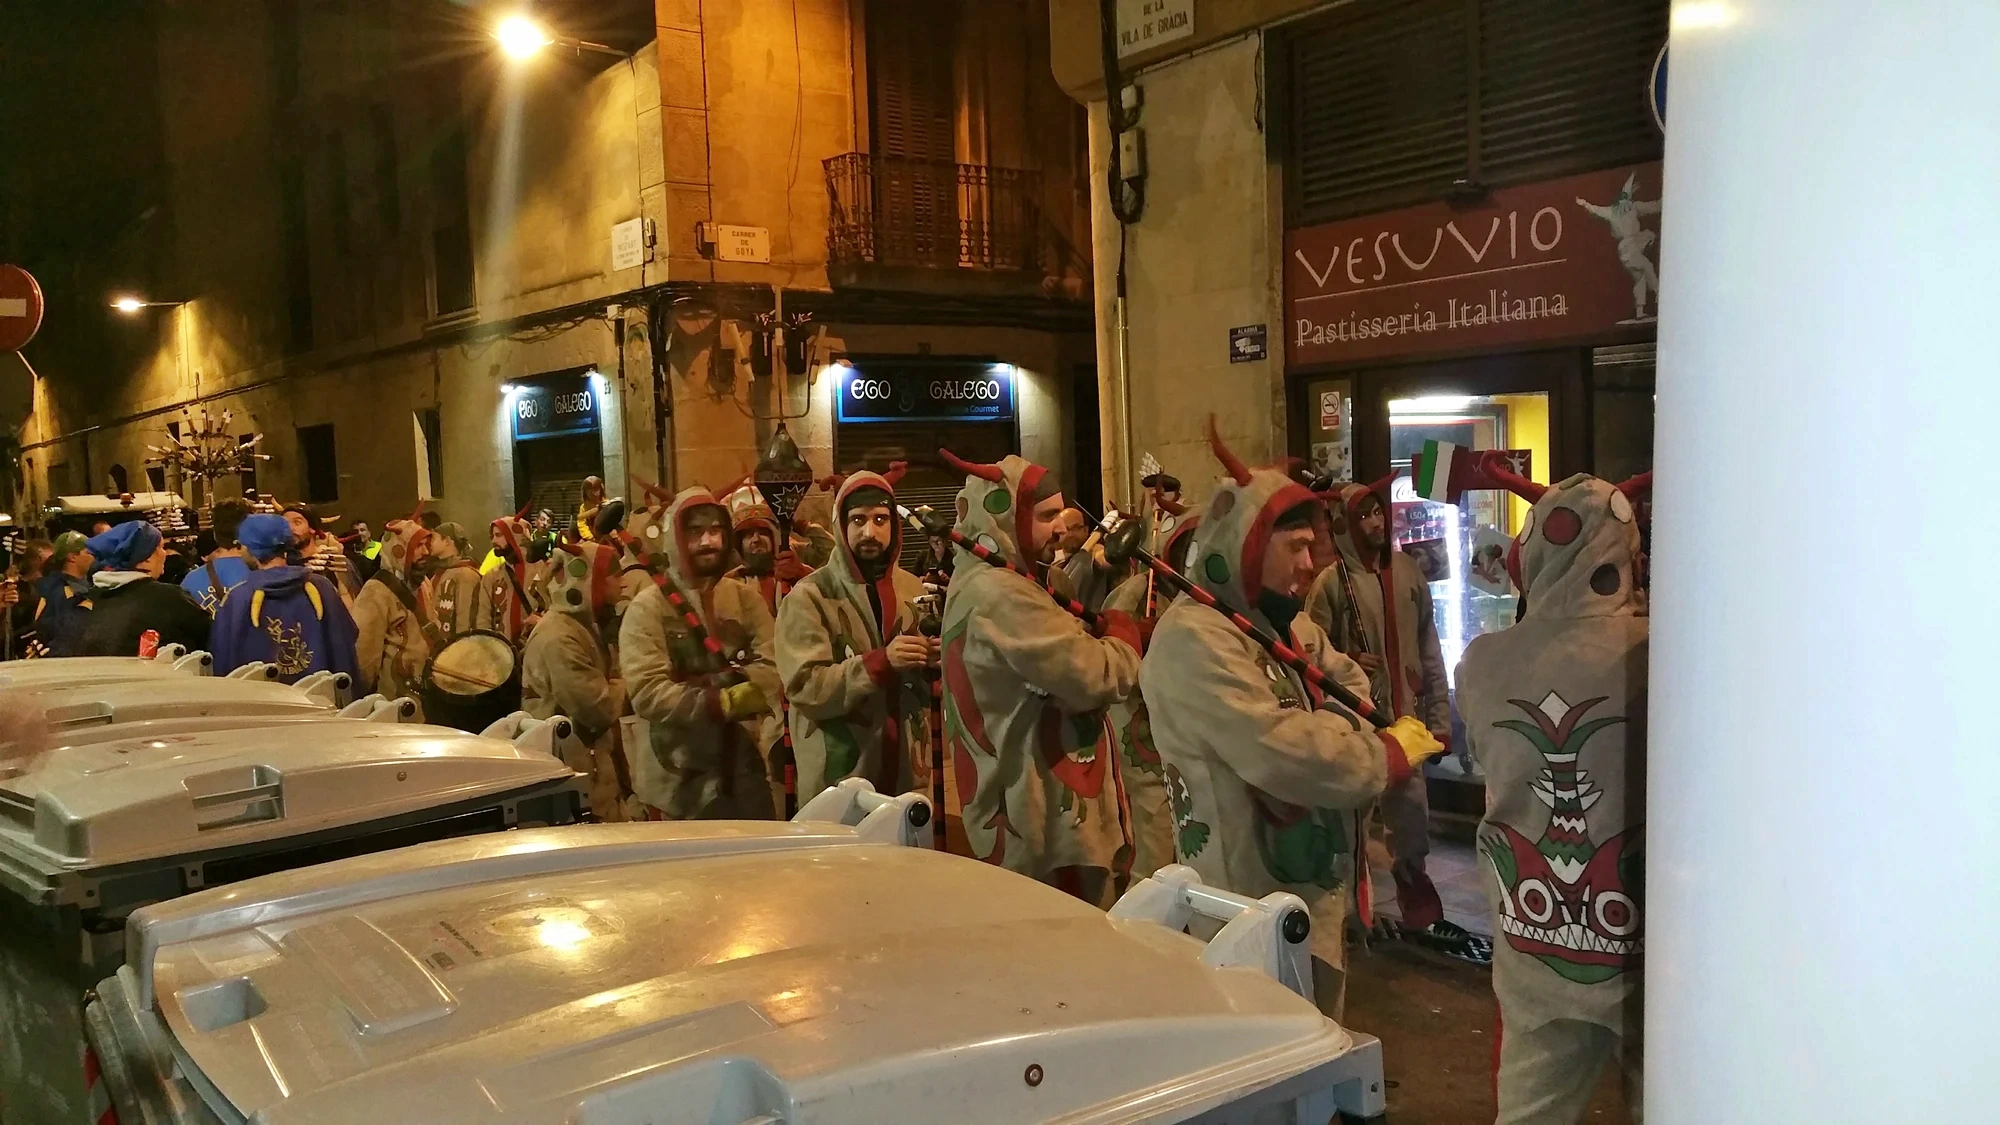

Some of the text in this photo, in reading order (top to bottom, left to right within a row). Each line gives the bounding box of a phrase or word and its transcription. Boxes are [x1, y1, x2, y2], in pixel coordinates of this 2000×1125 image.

[1143, 0, 1164, 16] DE LA
[1121, 10, 1188, 46] VILA DE GRÀCIA
[731, 230, 756, 238] CARRER
[735, 247, 755, 256] GOYA
[1295, 206, 1563, 288] VESUVIO
[1295, 289, 1568, 347] Pastisseria Italiana
[851, 378, 1000, 400] EGO GALEGO
[518, 390, 592, 419] EGO GALEGO
[969, 404, 1000, 413] Gourmet
